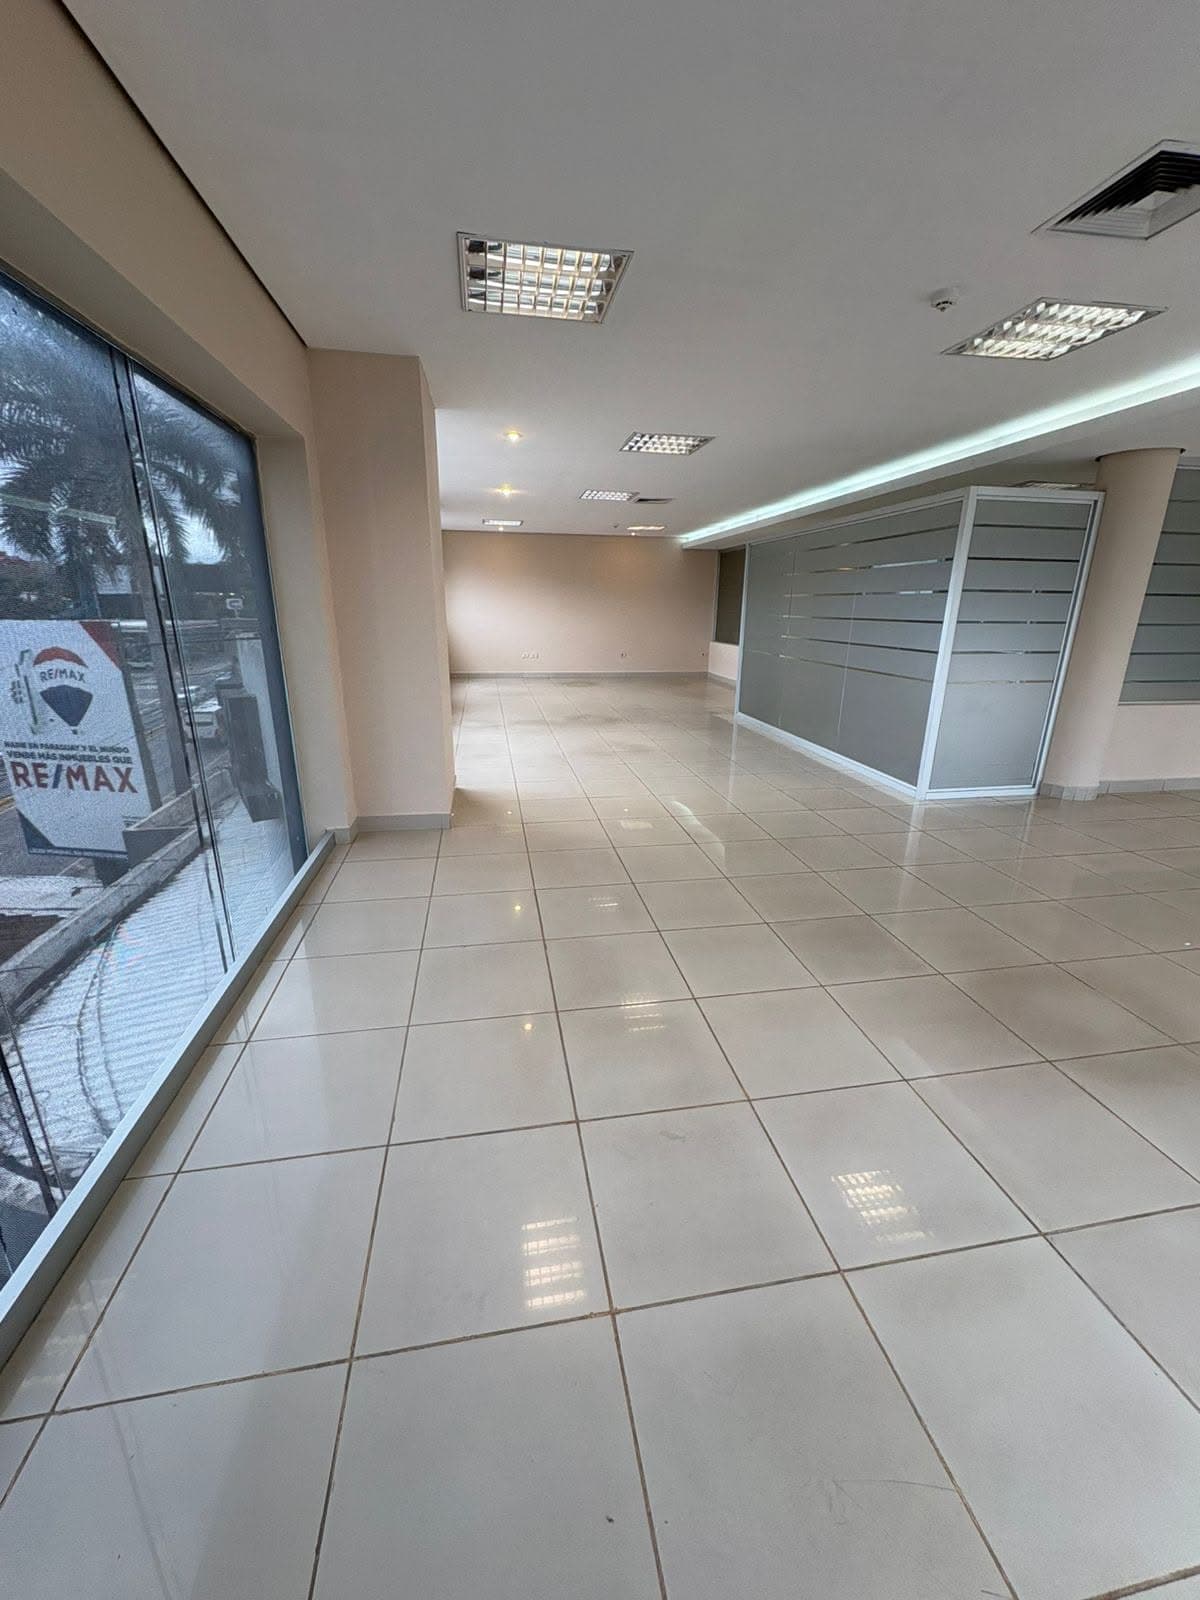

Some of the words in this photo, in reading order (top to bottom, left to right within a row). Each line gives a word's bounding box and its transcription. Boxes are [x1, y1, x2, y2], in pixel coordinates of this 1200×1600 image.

[40, 668, 86, 683] RE/MAX
[40, 743, 79, 751] PARAGUAY
[6, 750, 36, 759] VENDE
[58, 753, 110, 762] INMUEBLES
[112, 756, 132, 764] QUE
[10, 761, 138, 793] RE/MAX
